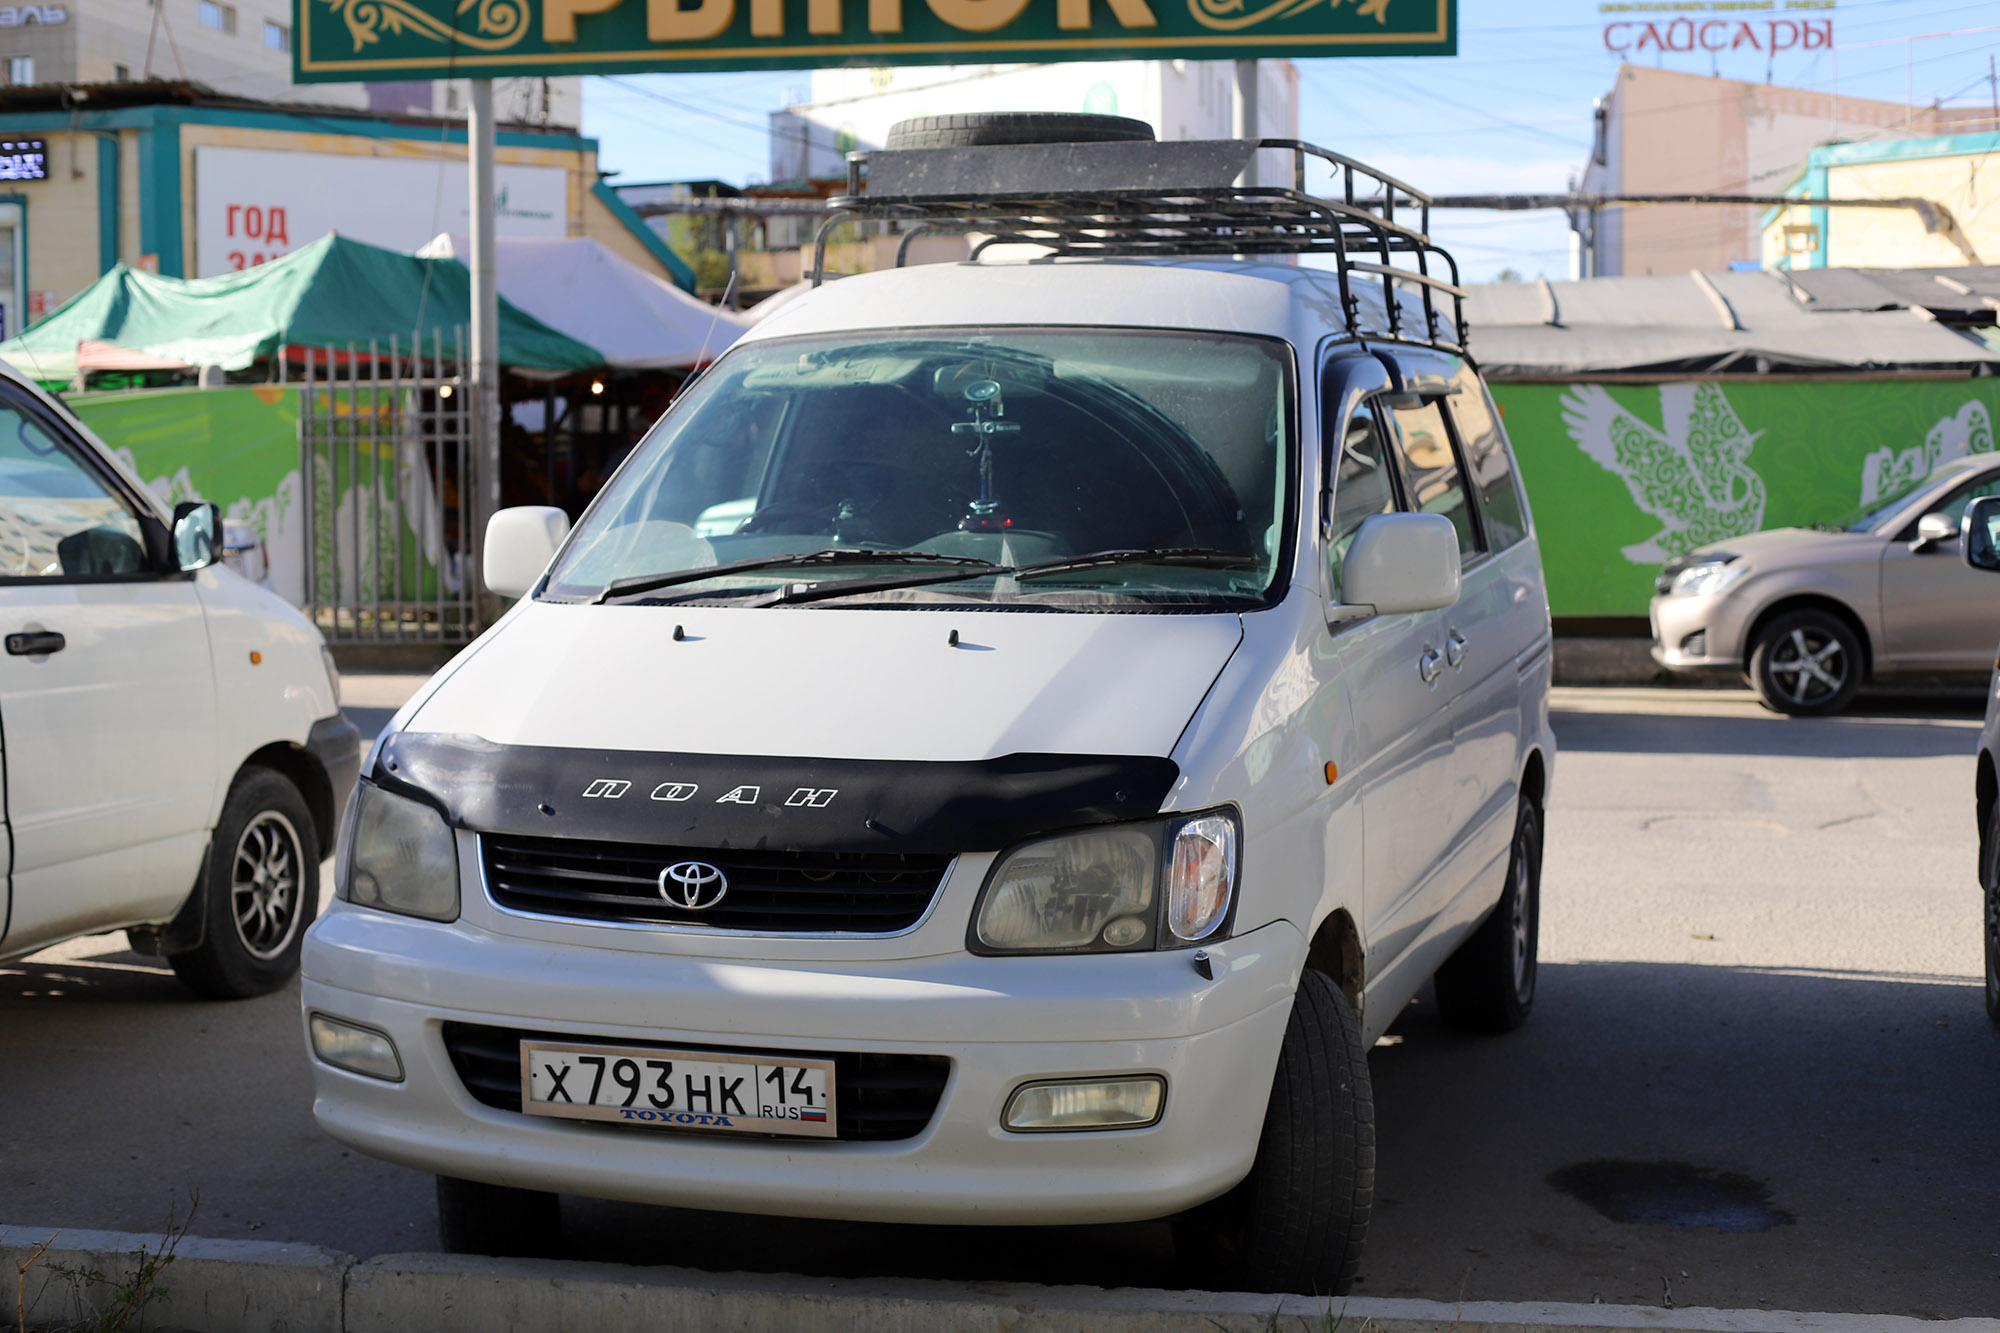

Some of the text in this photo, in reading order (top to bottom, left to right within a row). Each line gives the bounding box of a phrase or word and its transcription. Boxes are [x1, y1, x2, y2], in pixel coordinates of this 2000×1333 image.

[226, 204, 288, 245] ГОД
[582, 779, 838, 807] NOAH
[765, 1066, 813, 1105] 14
[620, 1109, 733, 1127] TOYOTA
[762, 1104, 799, 1120] RUS
